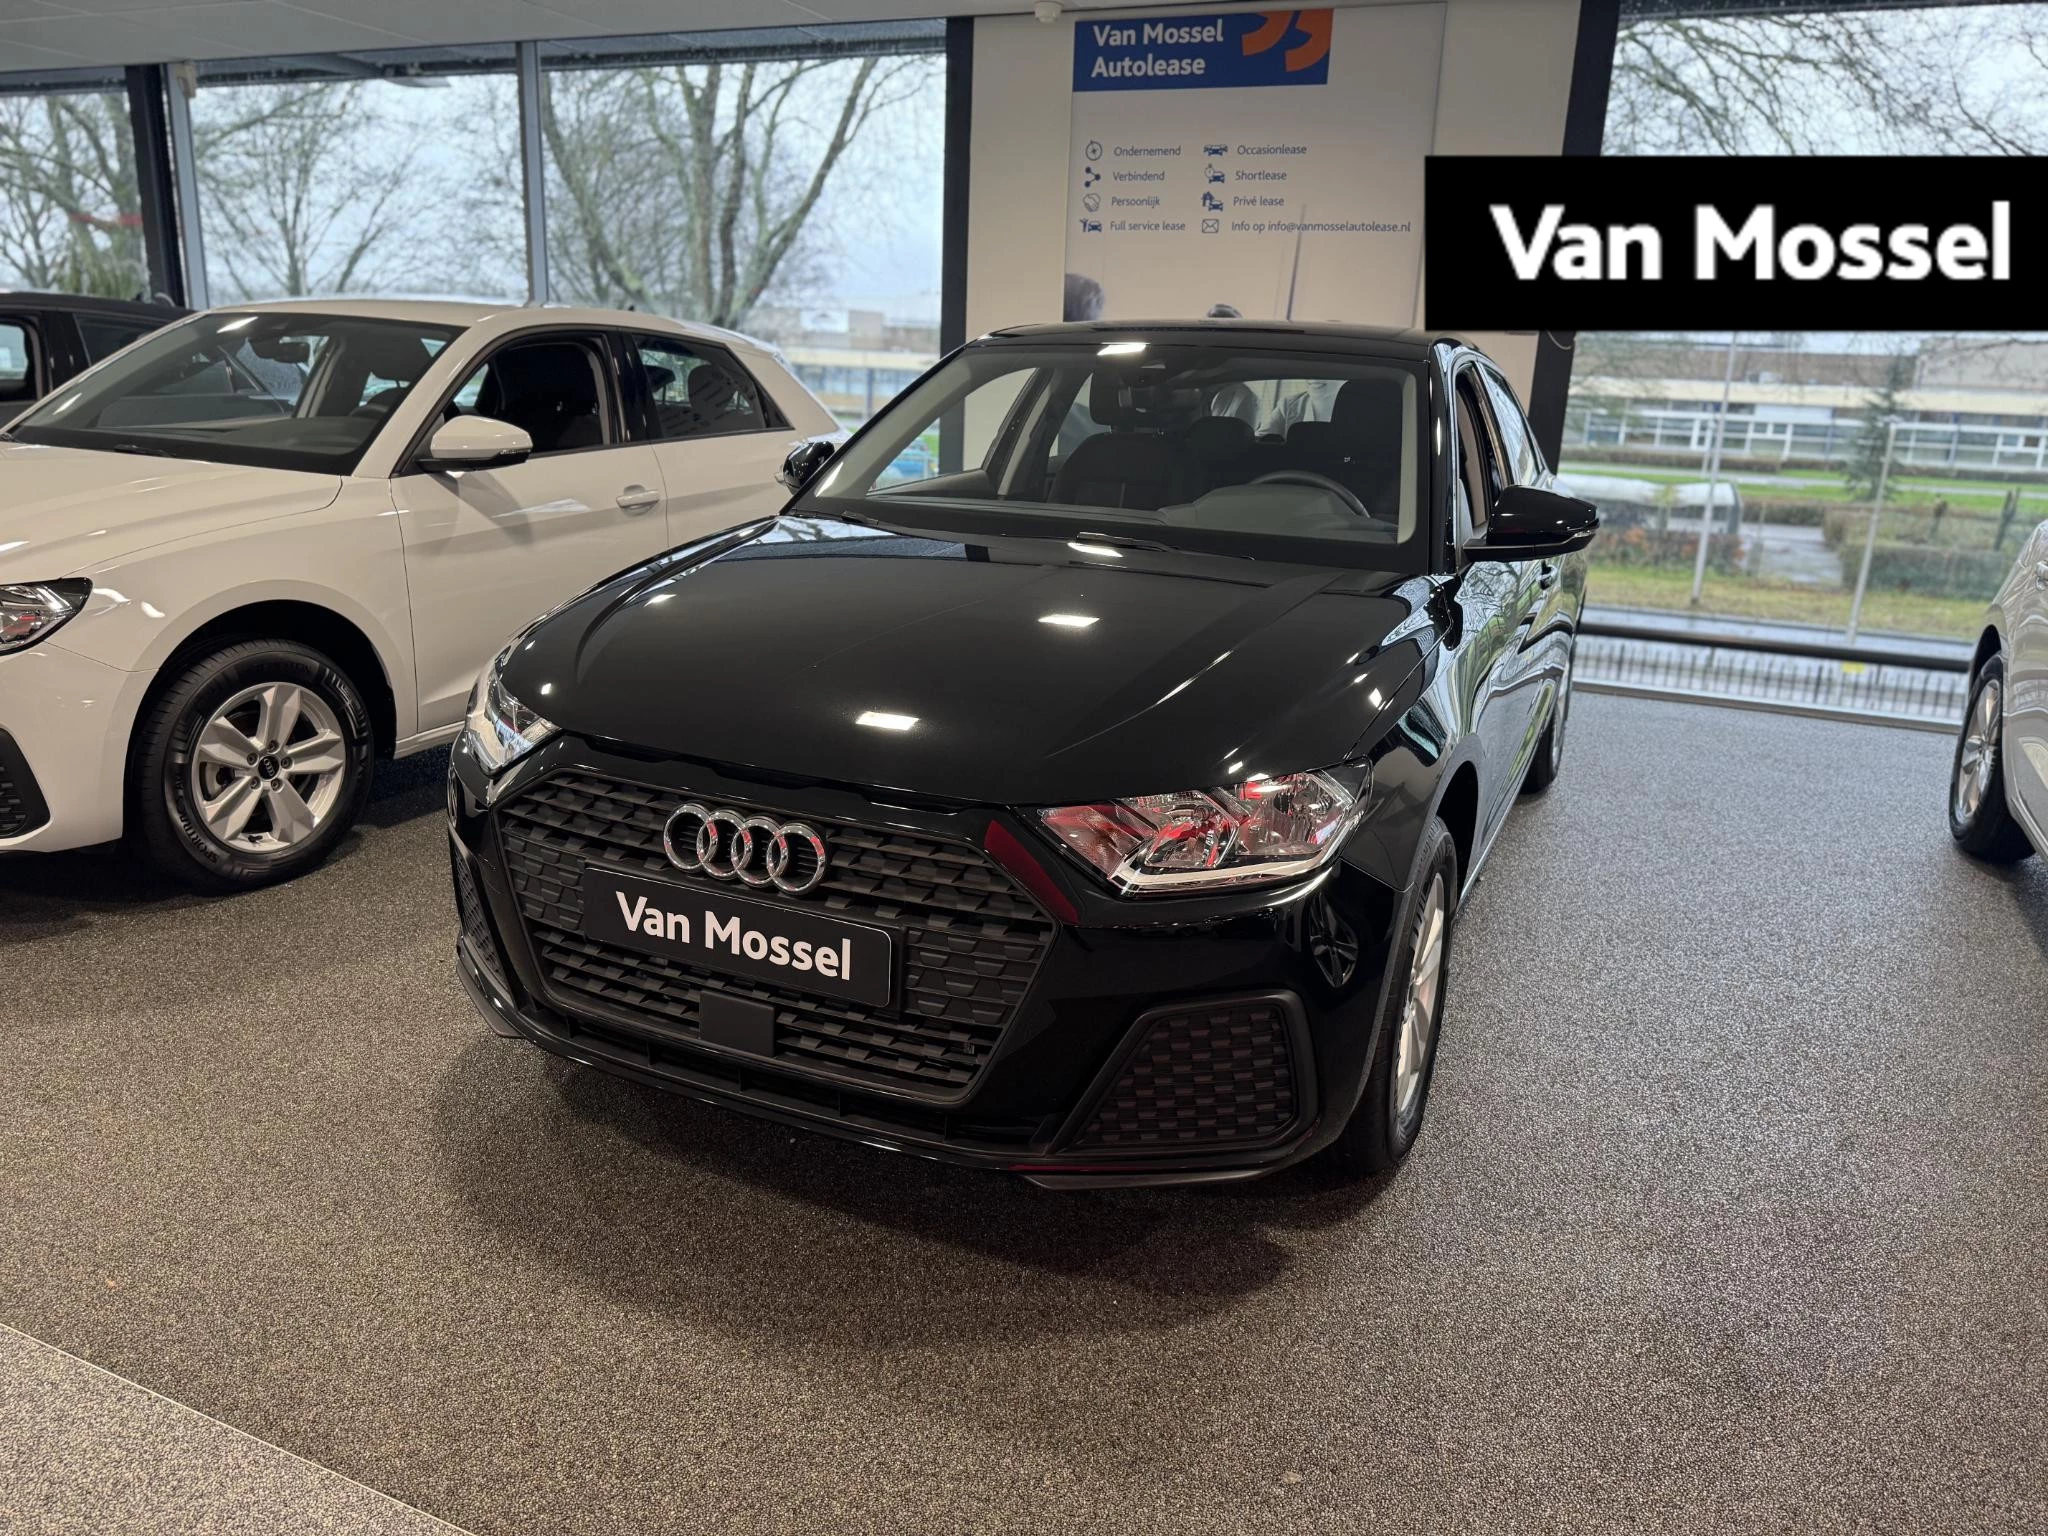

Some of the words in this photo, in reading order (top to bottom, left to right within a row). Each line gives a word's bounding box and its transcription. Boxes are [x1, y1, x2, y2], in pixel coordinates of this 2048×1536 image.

[1093, 25, 1136, 47] Van
[1143, 19, 1224, 45] Mossel
[1091, 53, 1206, 78] Autolease
[1113, 145, 1182, 157] Ondernemend
[1236, 144, 1308, 156] Occasionlease
[1112, 170, 1166, 182] Verbindend
[1235, 169, 1288, 181] Shortlease
[1111, 195, 1161, 209] Persoonlijk
[1233, 195, 1257, 207] Privé
[1259, 195, 1285, 207] lease
[1109, 219, 1127, 231] Full
[1128, 220, 1160, 231] service
[1162, 220, 1186, 231] lease
[1231, 219, 1252, 231] Info
[1254, 223, 1267, 235] op
[1268, 219, 1412, 233] info@vanmosselautolease.nl
[616, 890, 691, 944] Van
[704, 910, 851, 981] Mossel
